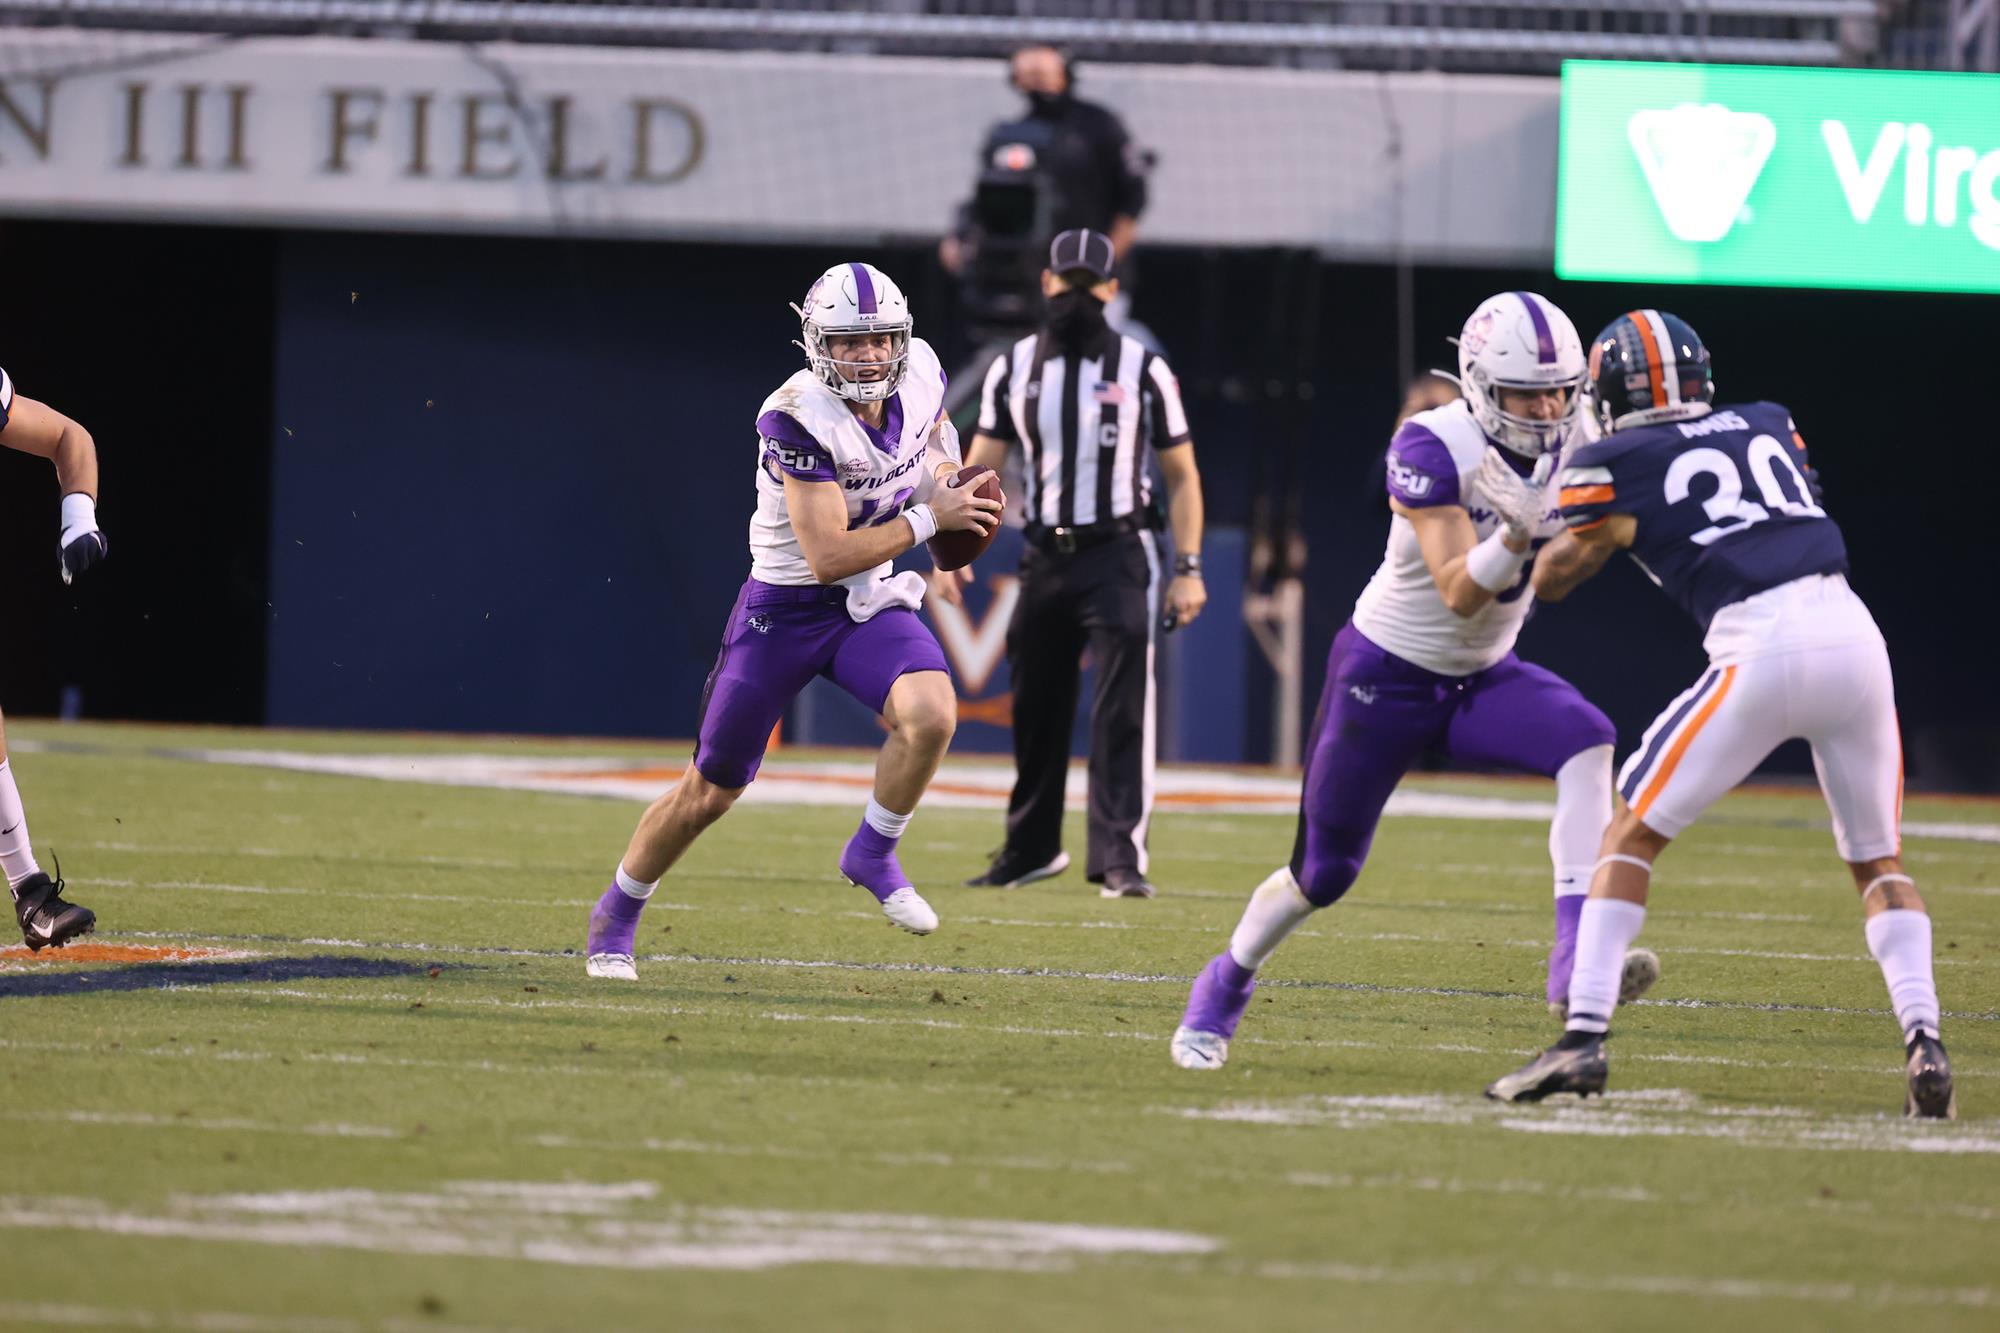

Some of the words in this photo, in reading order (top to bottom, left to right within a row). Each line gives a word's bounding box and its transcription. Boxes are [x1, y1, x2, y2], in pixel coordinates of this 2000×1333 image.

[117, 80, 252, 171] III
[320, 85, 710, 185] FIELD
[1821, 119, 2000, 251] Virg
[767, 439, 817, 472] ACU
[1100, 422, 1118, 448] C
[1664, 433, 1828, 546] 30
